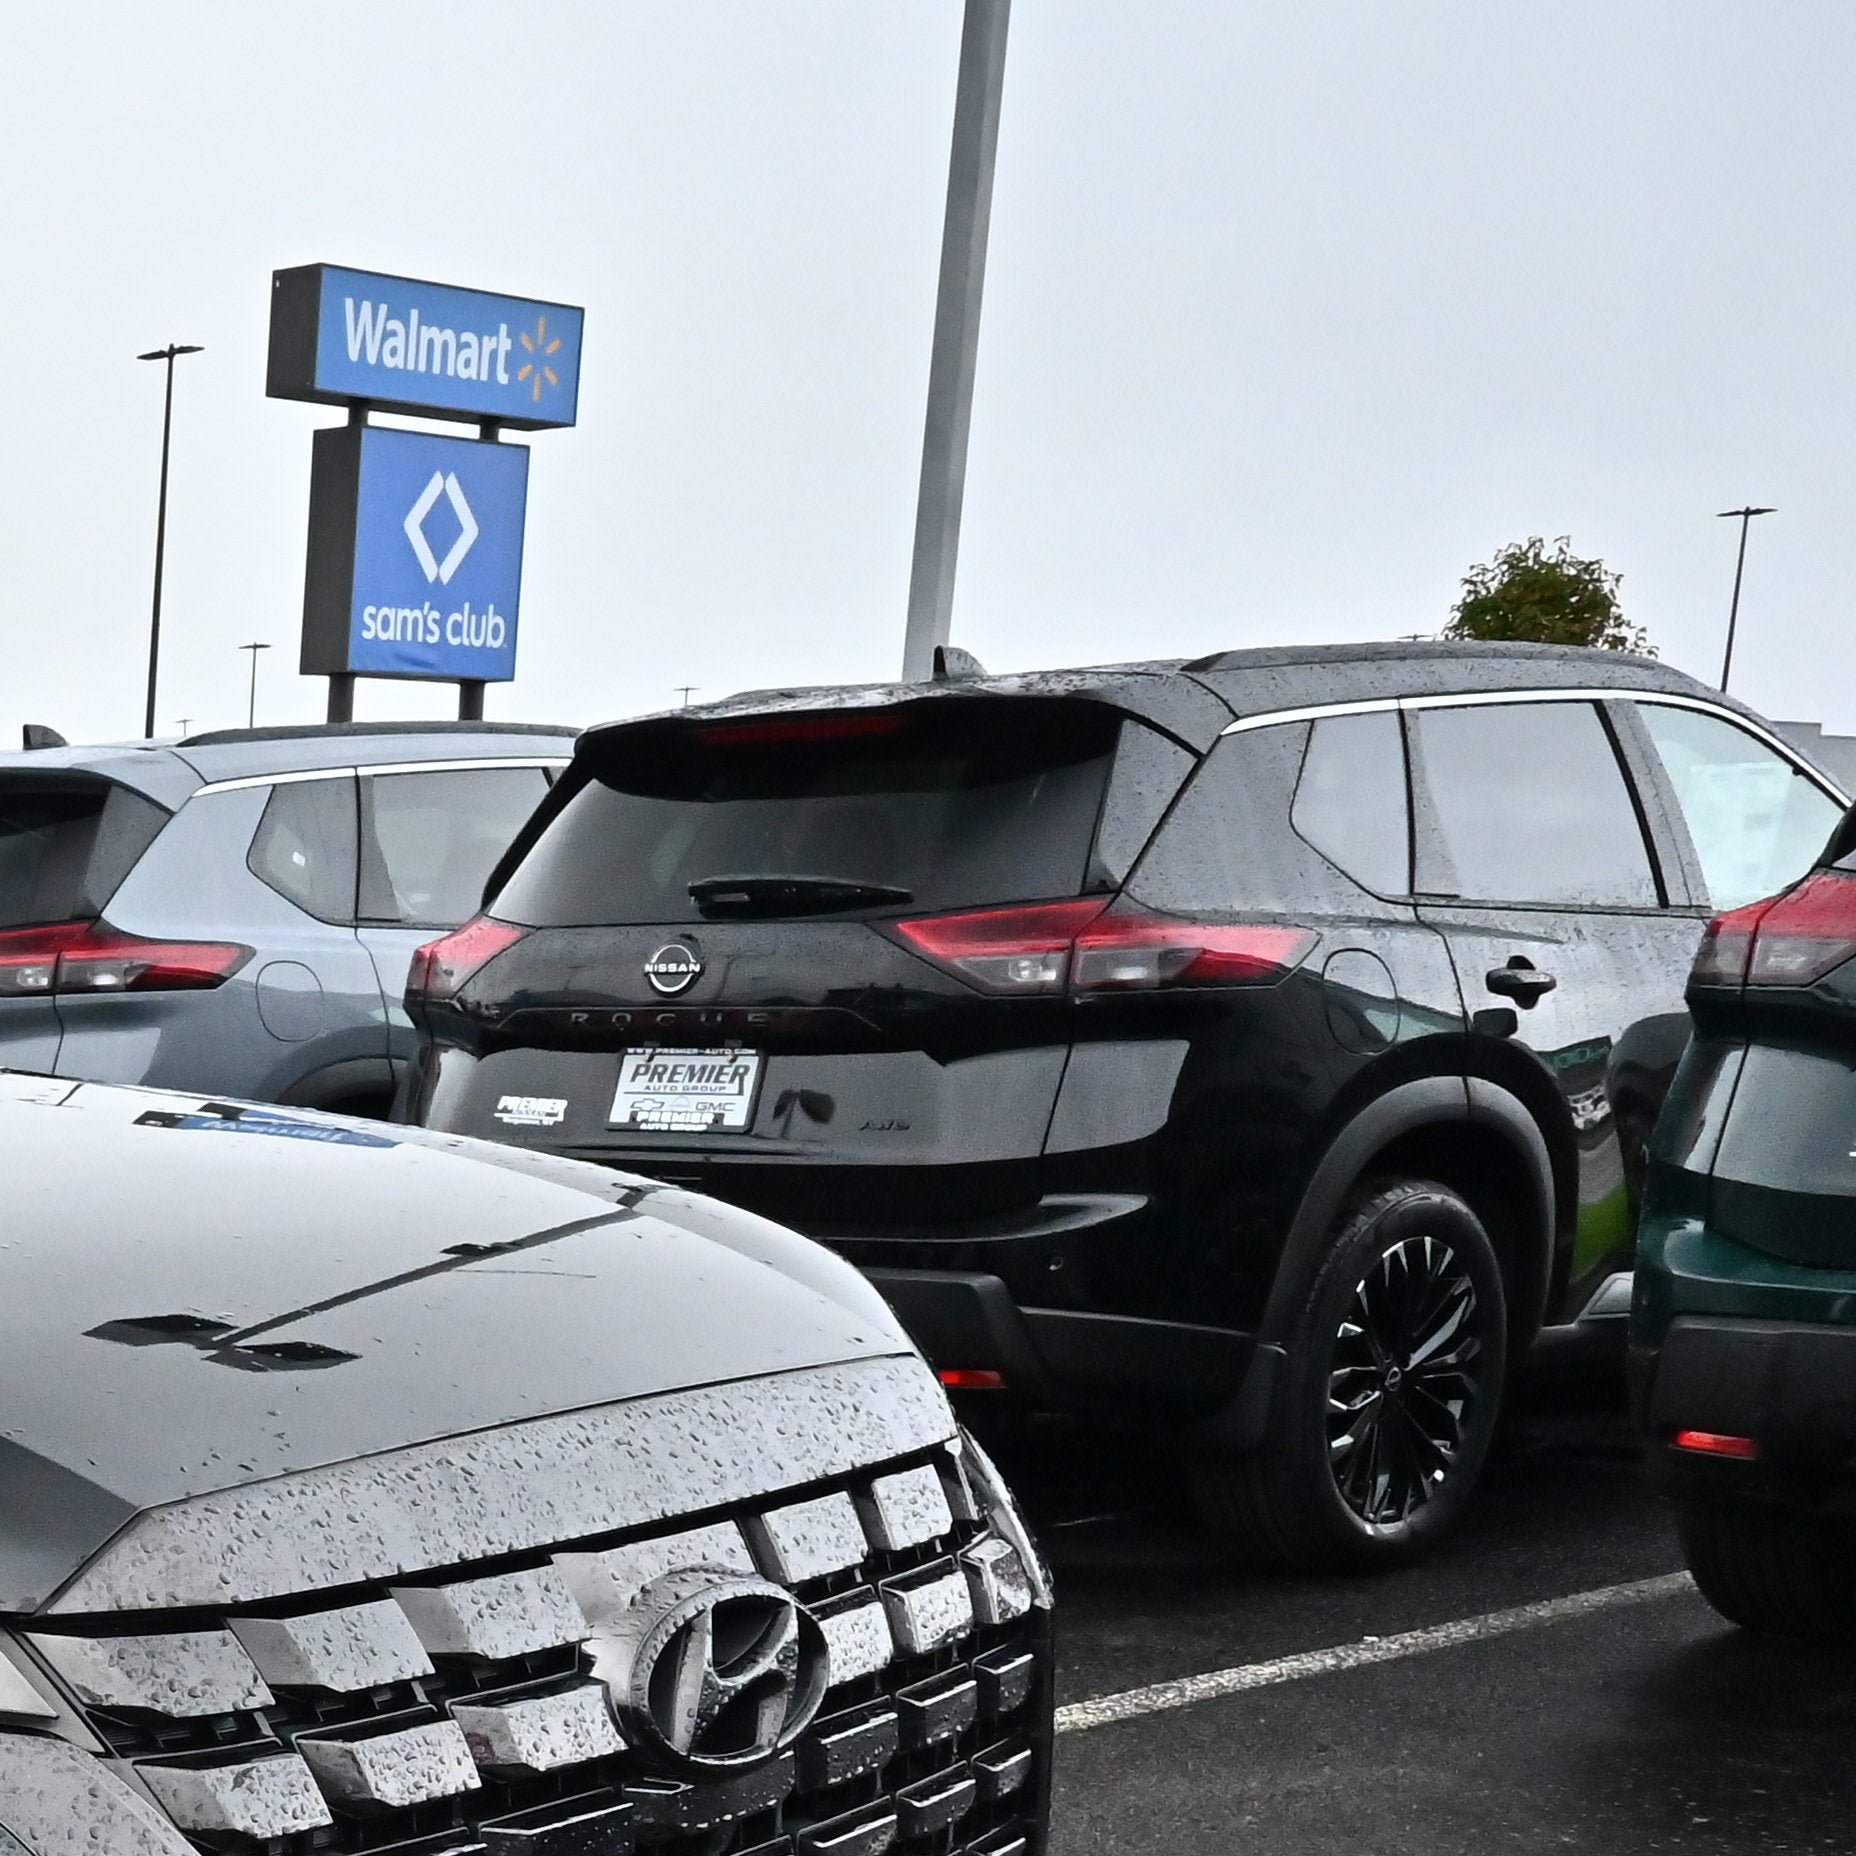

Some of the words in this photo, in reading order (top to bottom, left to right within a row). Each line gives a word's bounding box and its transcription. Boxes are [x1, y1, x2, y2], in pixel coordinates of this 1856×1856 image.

[344, 297, 512, 385] Walmart
[361, 601, 441, 644] sam's
[446, 601, 506, 649] club
[644, 962, 701, 973] NISSAN
[570, 1012, 769, 1027] ROGUE
[630, 1063, 751, 1085] PREMIER
[644, 1084, 678, 1092] AUTO
[695, 1101, 736, 1112] GMC
[636, 1110, 715, 1124] PREMIER
